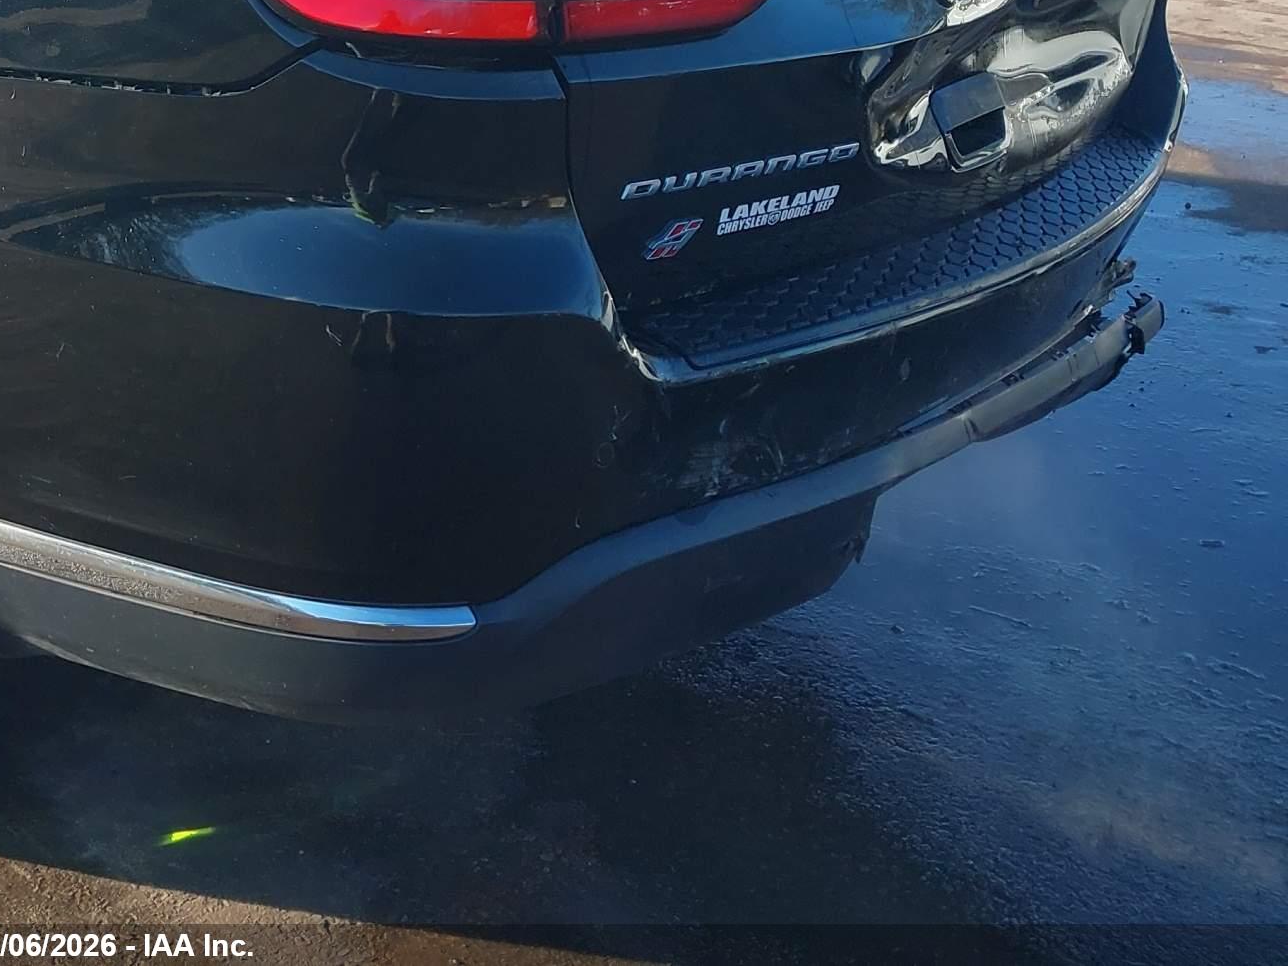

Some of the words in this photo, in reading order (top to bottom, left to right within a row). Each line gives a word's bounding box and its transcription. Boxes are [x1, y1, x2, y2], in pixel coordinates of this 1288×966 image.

[620, 142, 860, 200] DURANGO
[716, 213, 769, 235] CHRYSLER
[780, 203, 813, 222] DODGE
[813, 198, 835, 214] JEEP
[719, 185, 840, 223] LAKELAND
